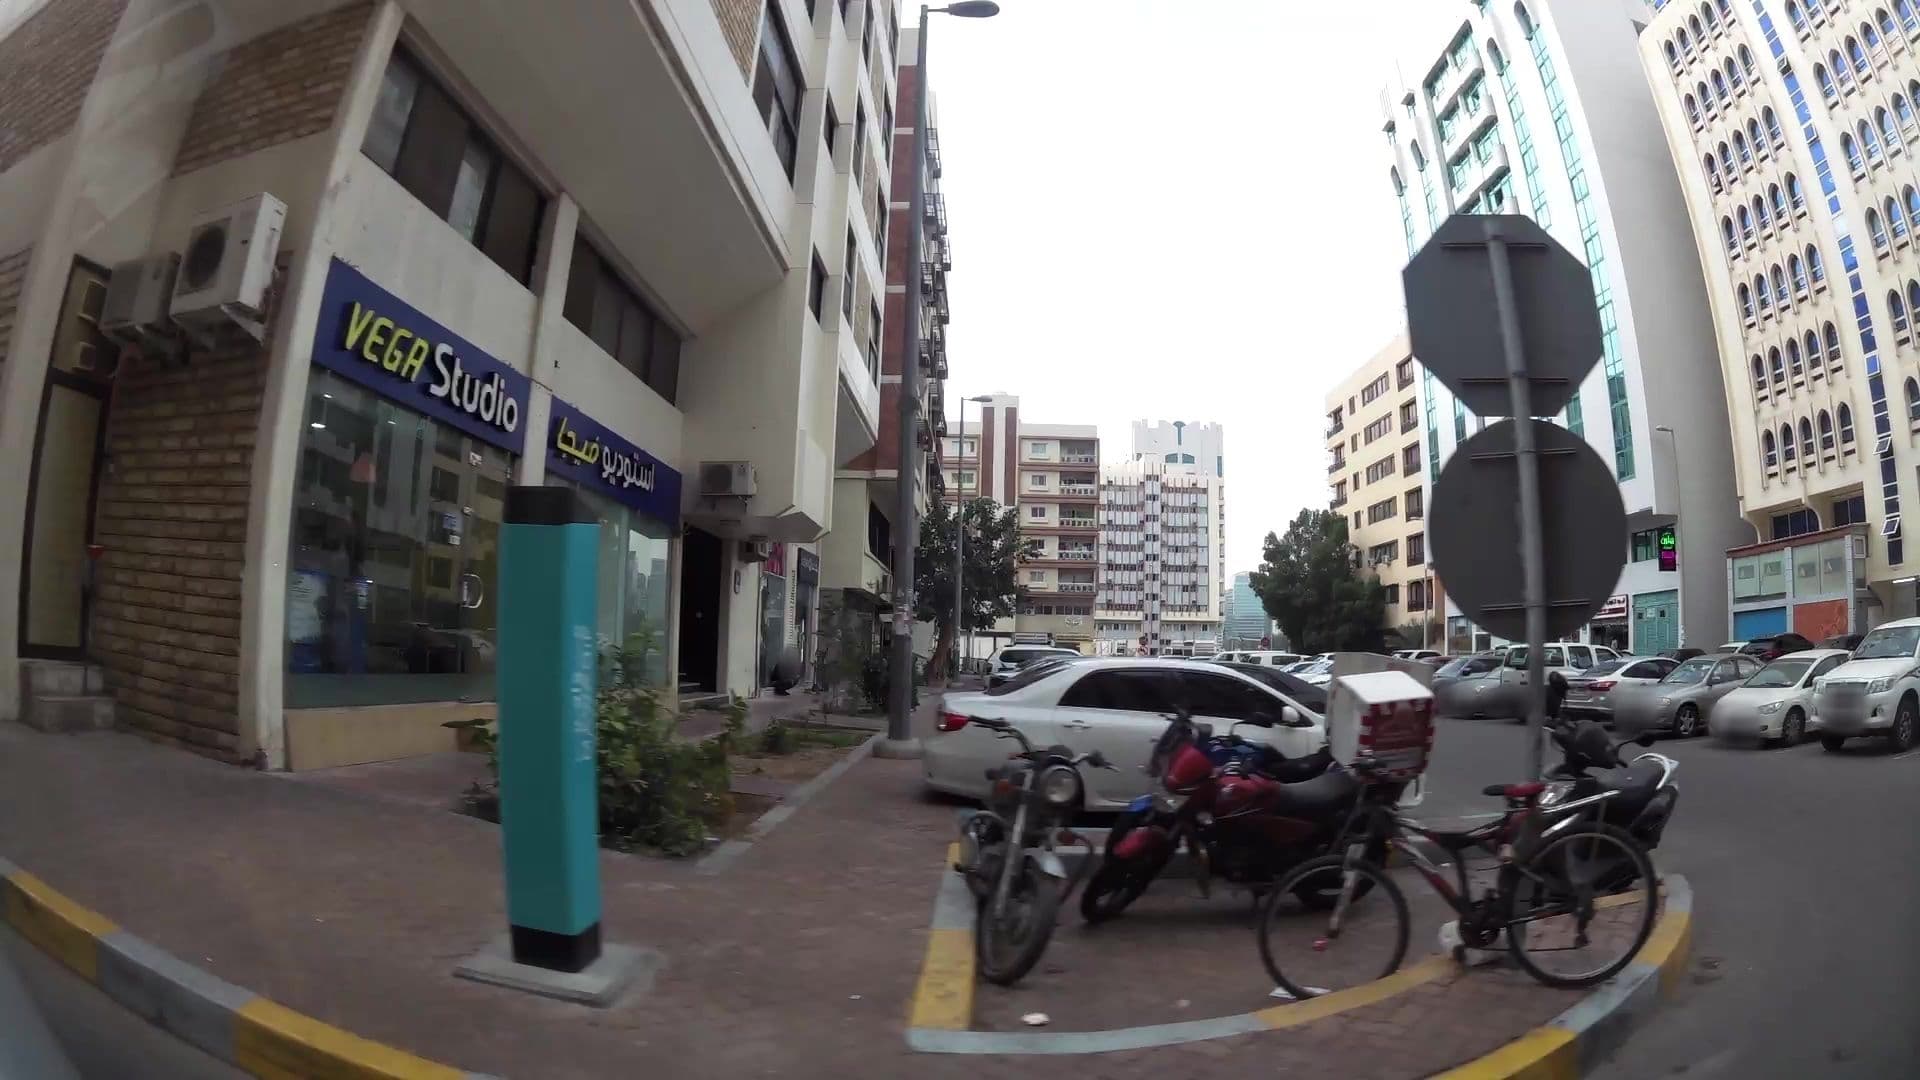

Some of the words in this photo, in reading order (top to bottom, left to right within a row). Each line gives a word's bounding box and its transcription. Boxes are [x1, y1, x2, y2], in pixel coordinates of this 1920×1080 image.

[345, 302, 430, 382] VEGA
[429, 342, 518, 432] Studio
[557, 417, 600, 466] فيجا
[602, 446, 655, 493] استوديو
